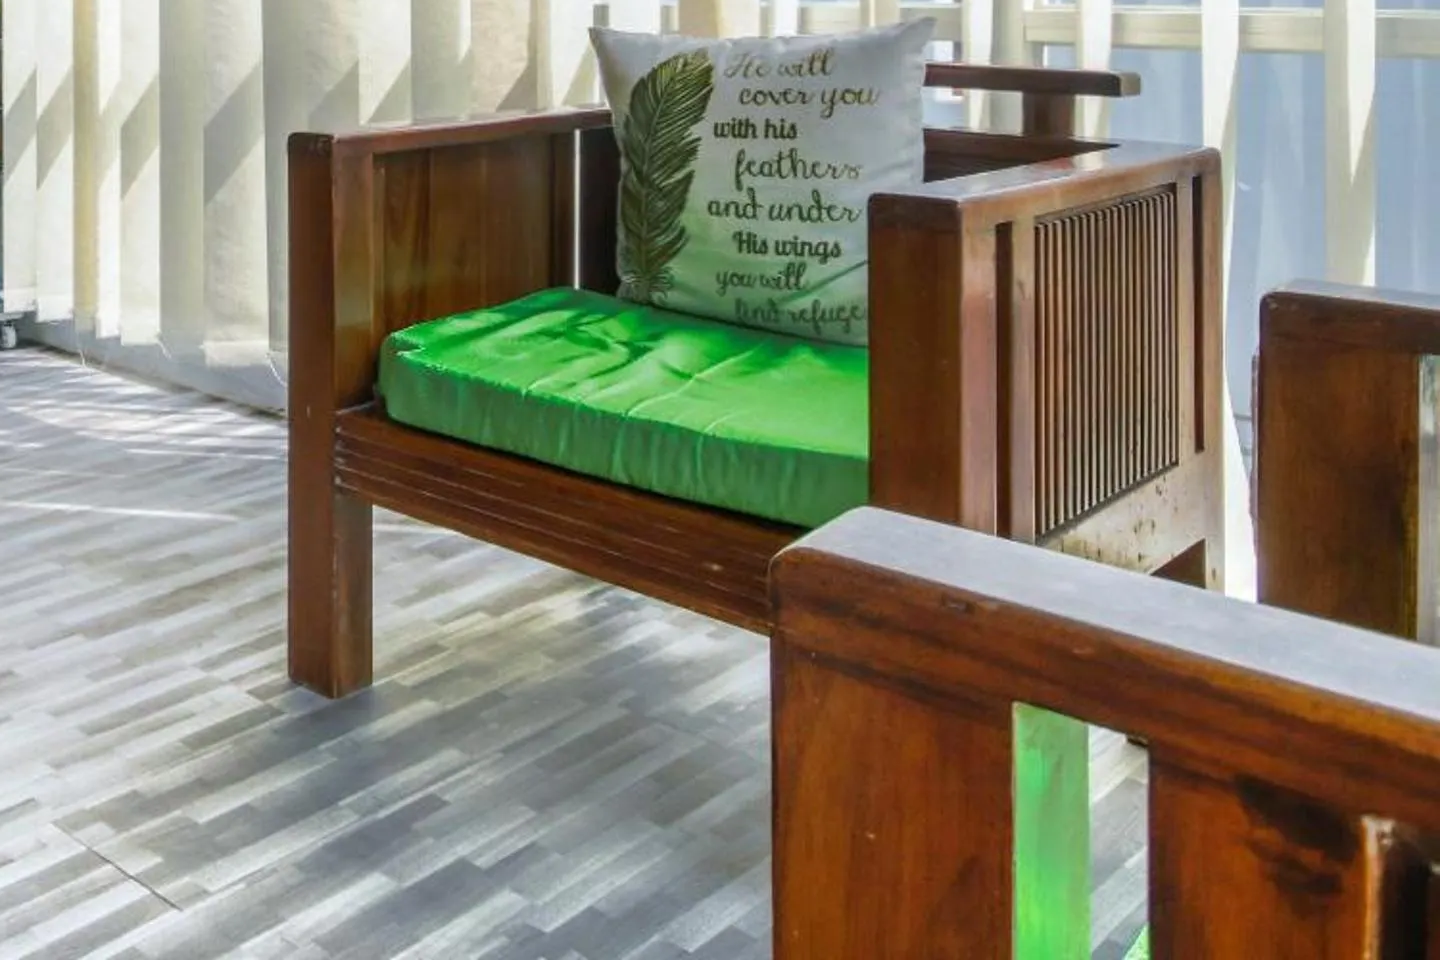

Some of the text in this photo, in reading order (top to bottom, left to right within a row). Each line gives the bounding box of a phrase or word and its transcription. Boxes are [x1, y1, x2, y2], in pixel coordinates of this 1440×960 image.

[723, 47, 835, 79] He will
[739, 87, 880, 119] cover you
[713, 116, 798, 139] with his
[733, 147, 863, 192] feathers
[707, 187, 862, 224] and under
[732, 230, 843, 265] His wings
[715, 261, 808, 297] you will
[787, 298, 868, 335] refuge
